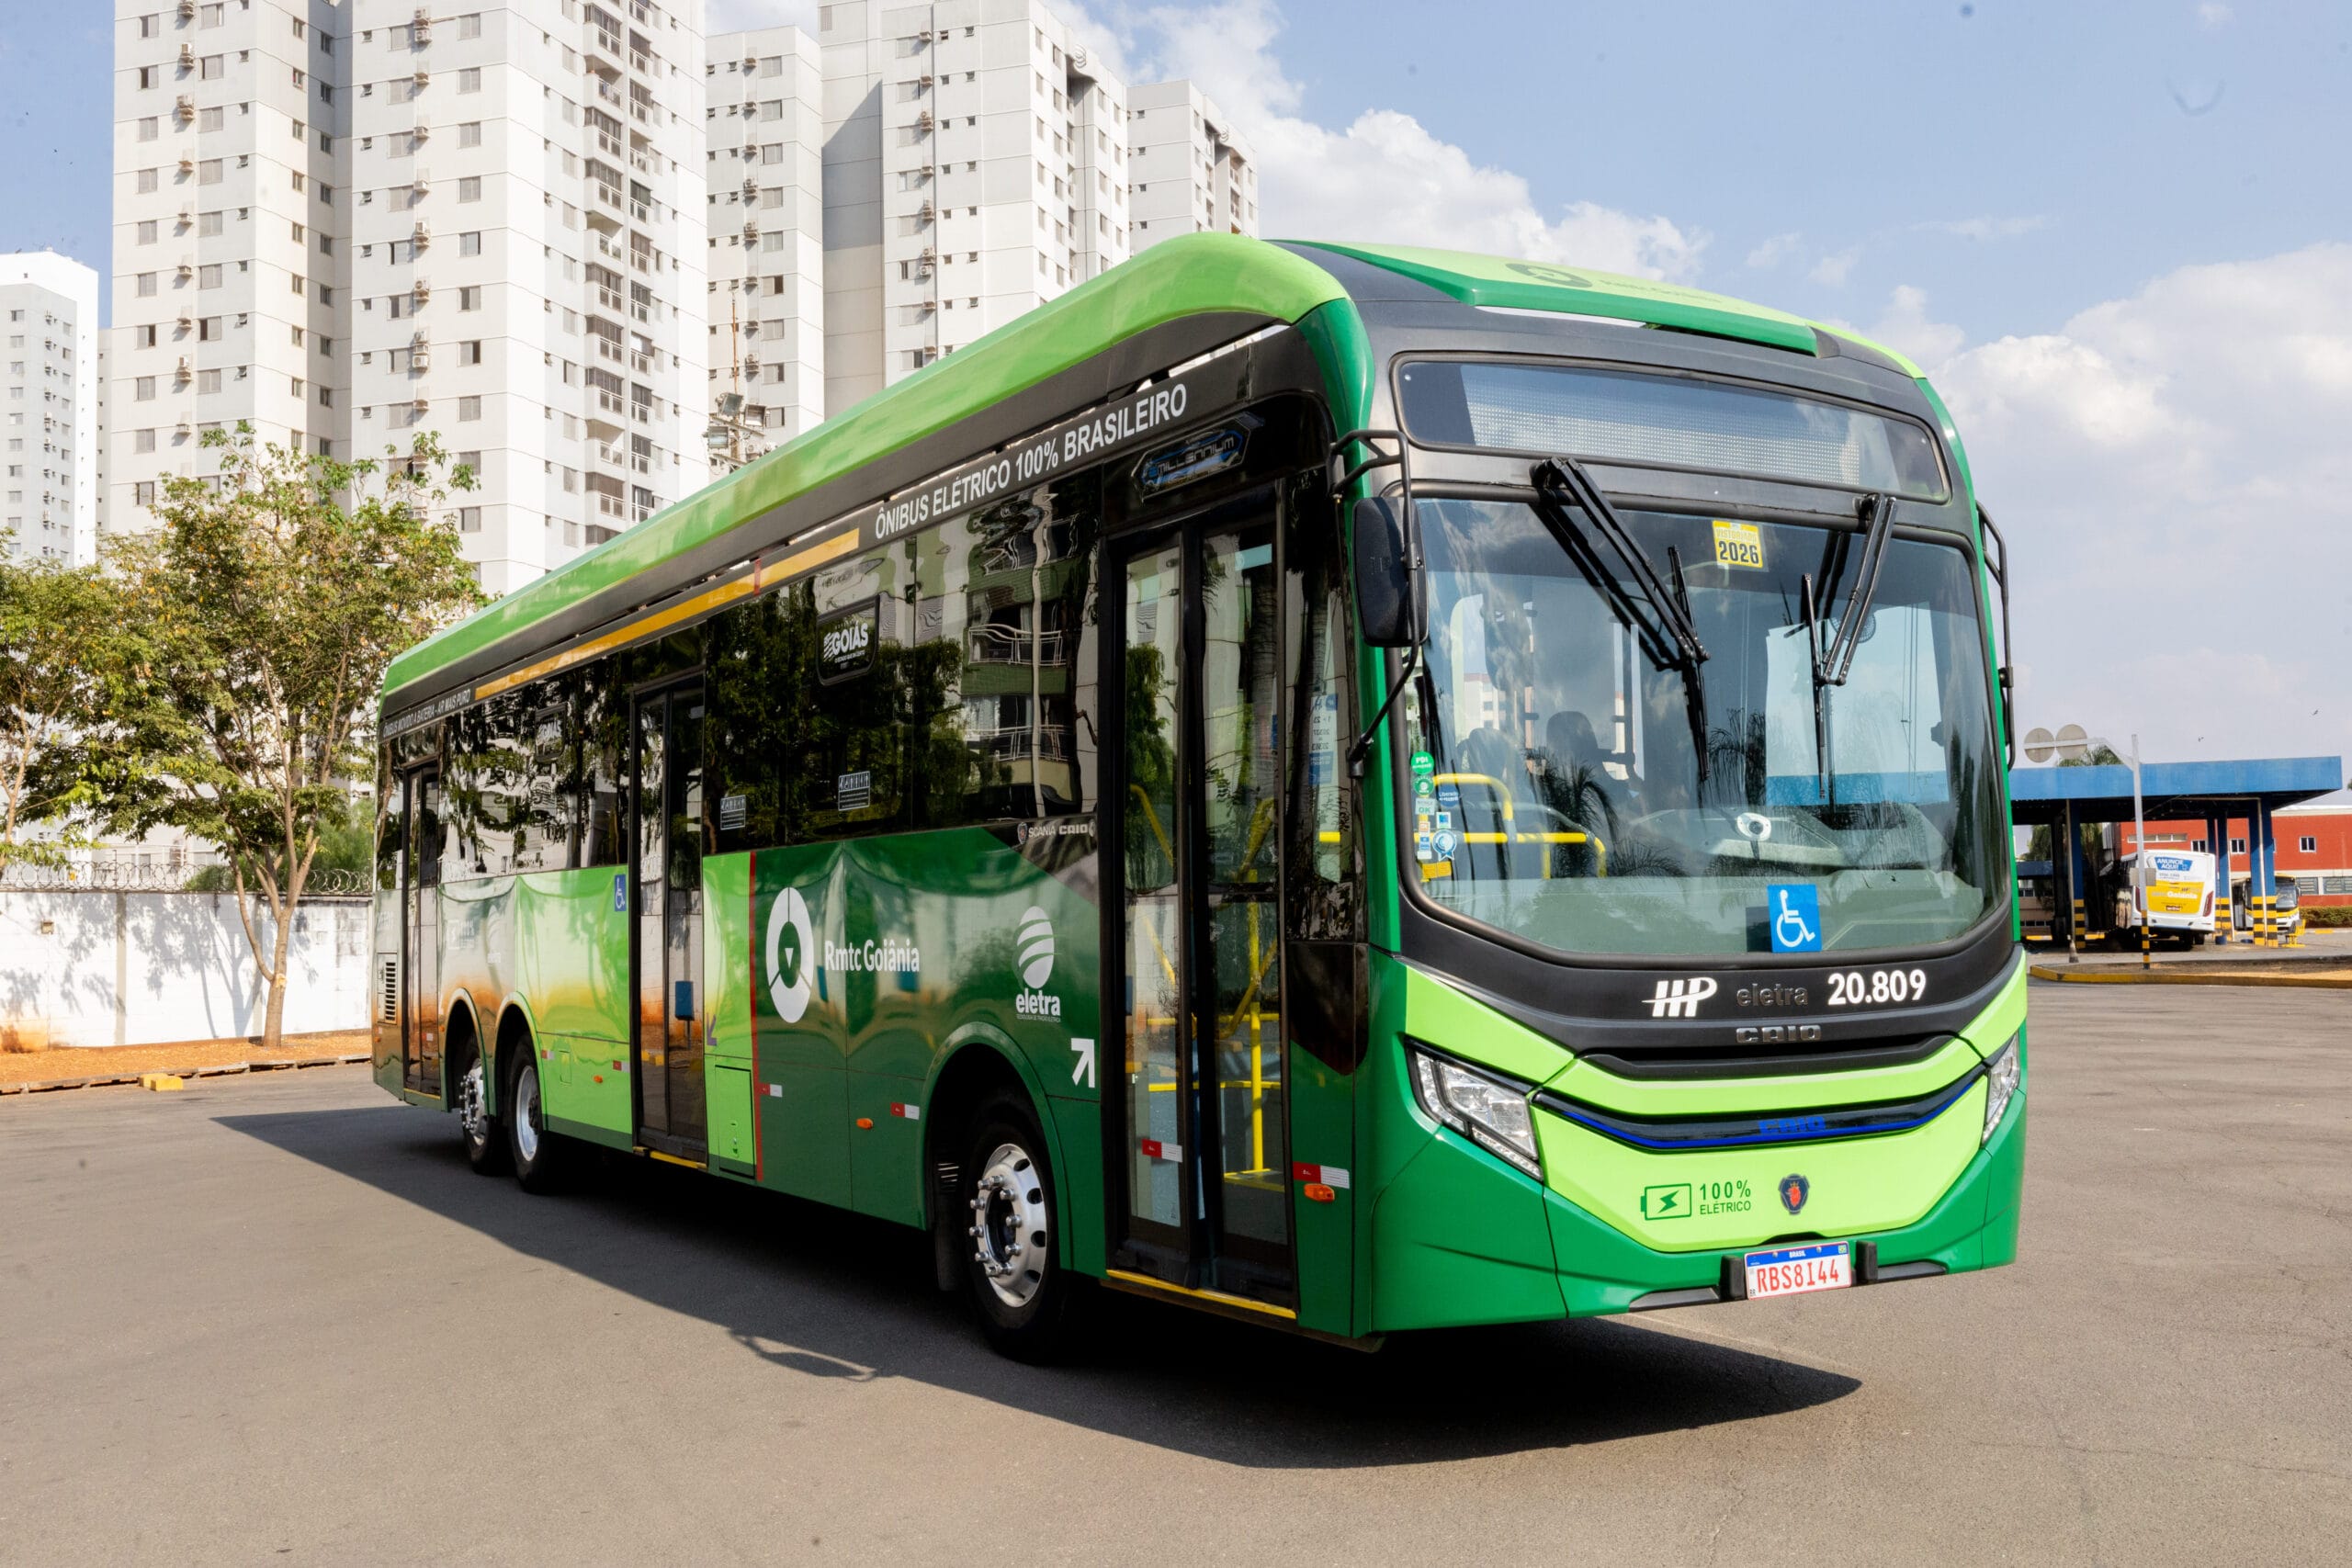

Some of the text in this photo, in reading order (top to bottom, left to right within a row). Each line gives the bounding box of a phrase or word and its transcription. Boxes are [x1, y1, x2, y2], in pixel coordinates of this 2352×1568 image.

[876, 383, 1187, 539] ÔNIBUS ELÉTRICO 100% BRASILEIRO
[1718, 540, 1759, 564] 2026
[831, 620, 869, 655] GOIÁS
[1028, 823, 1089, 838] SCANIA CAIO
[824, 938, 920, 972] Rmtc Goiânia
[1736, 983, 1809, 1008] eletra
[1826, 969, 1927, 1006] 20.809
[1015, 987, 1061, 1016] eletra
[1699, 1179, 1751, 1201] 100%
[1699, 1200, 1751, 1215] ELÉTRICO
[1788, 1249, 1807, 1258] BRASIL
